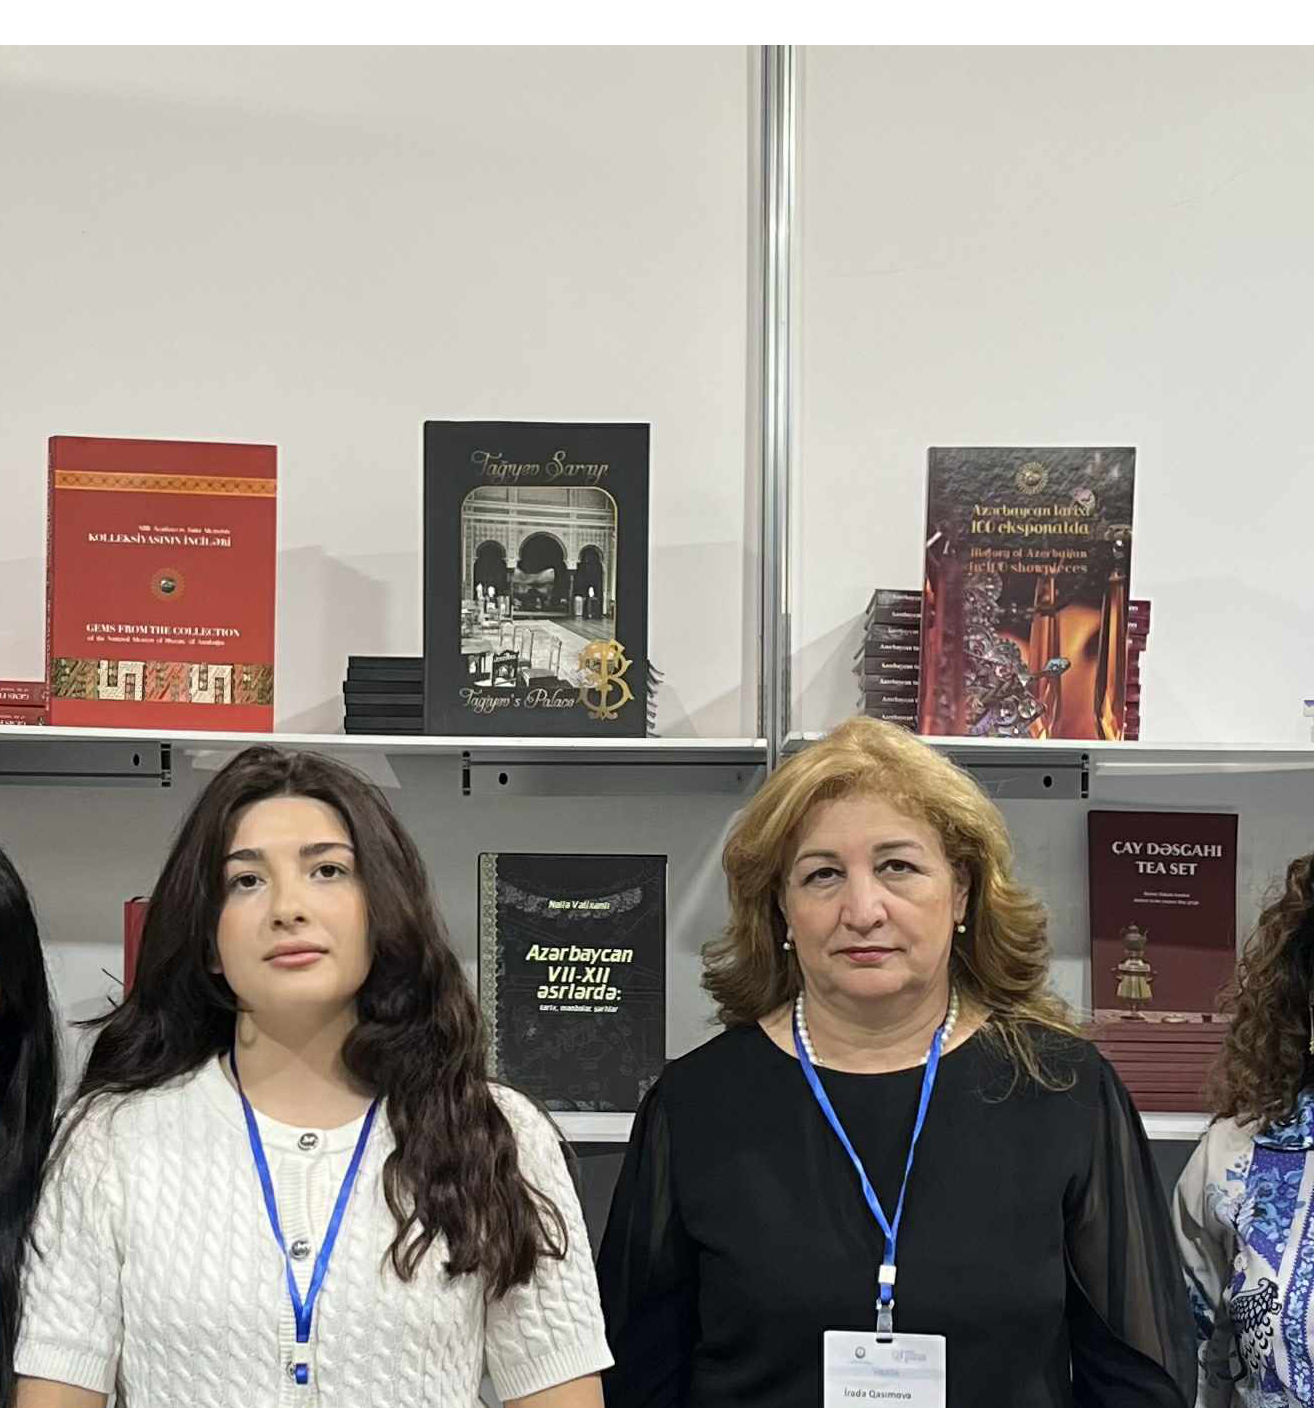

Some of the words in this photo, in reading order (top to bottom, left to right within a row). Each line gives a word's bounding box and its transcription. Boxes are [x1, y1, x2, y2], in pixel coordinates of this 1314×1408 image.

[972, 504, 1052, 520] Azərbaycan
[998, 520, 1089, 536] eksponatda
[88, 532, 181, 546] KOLLEKSİYASININ
[86, 623, 116, 633] GEMS
[118, 624, 147, 634] FROM
[149, 625, 172, 635] THE
[173, 627, 240, 637] COLLECTION
[1146, 842, 1222, 857] DƏSGAHI
[1135, 861, 1166, 874] TEA
[1169, 862, 1198, 875] SET
[525, 944, 634, 964] Azərbaycan
[548, 966, 611, 983] VII-XII
[537, 983, 622, 1000] əsrlərdə:
